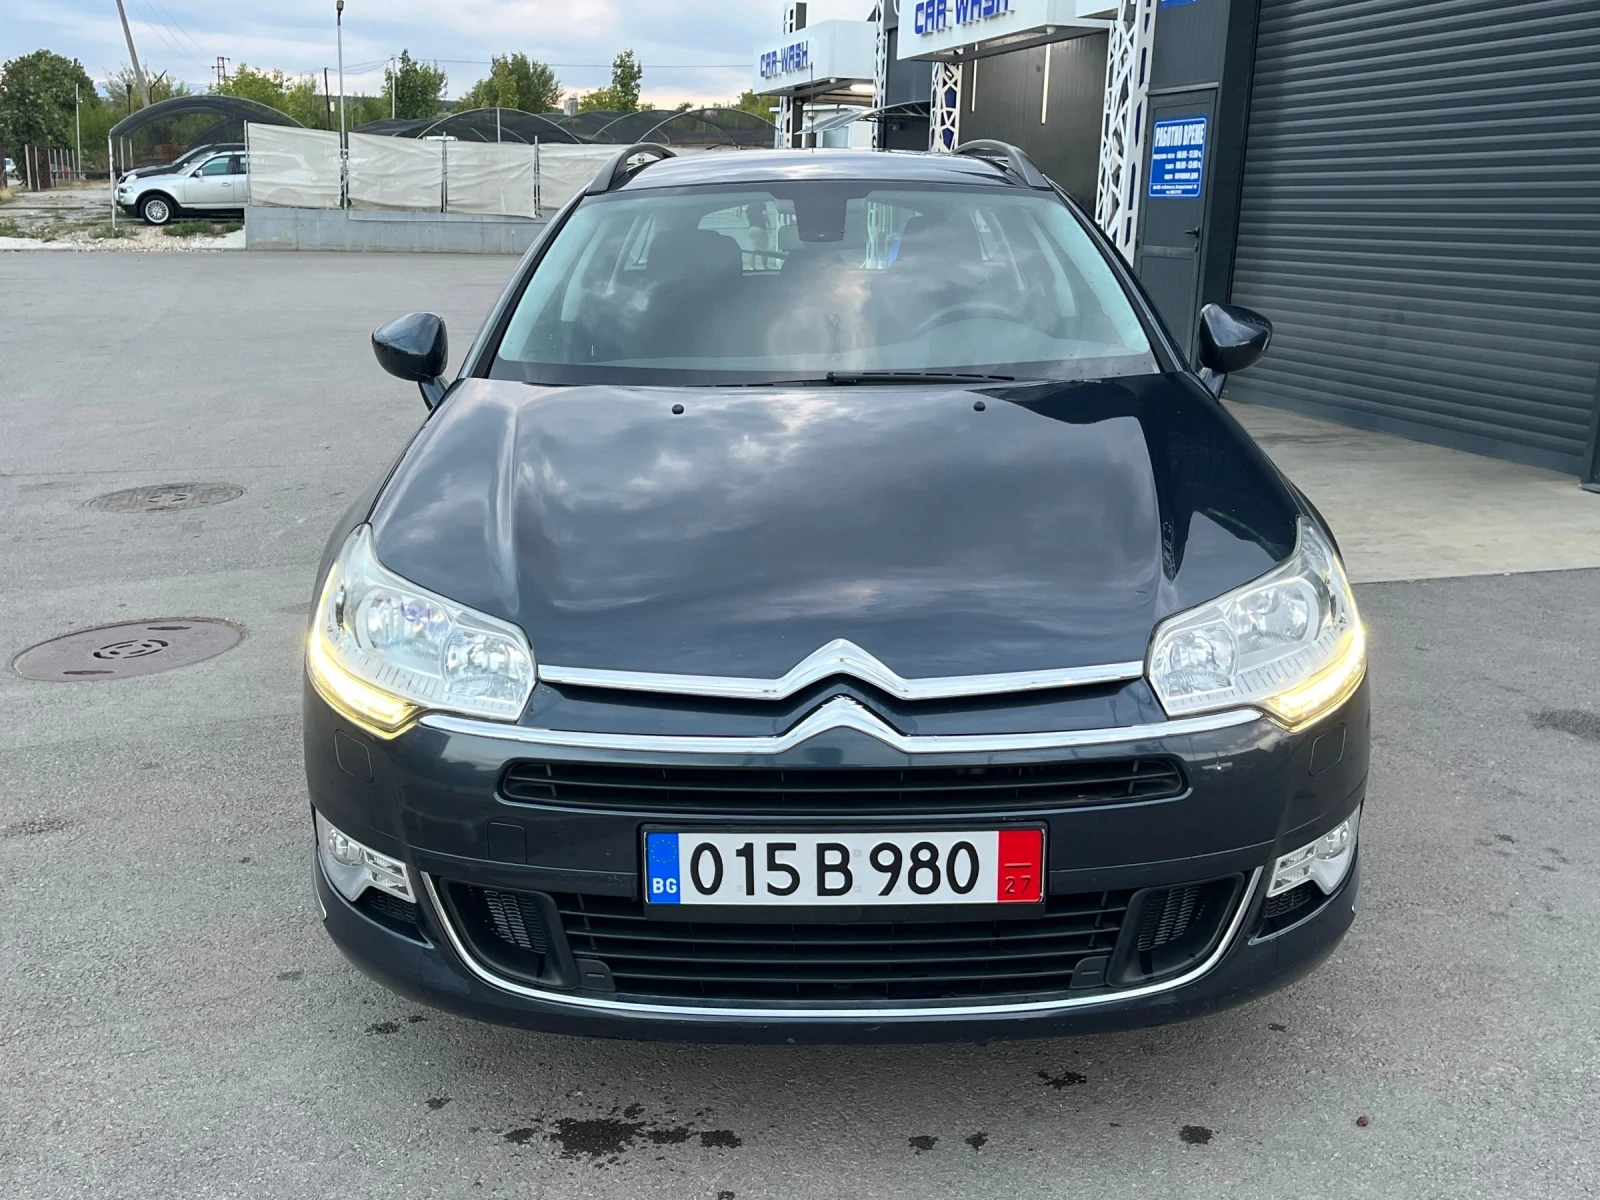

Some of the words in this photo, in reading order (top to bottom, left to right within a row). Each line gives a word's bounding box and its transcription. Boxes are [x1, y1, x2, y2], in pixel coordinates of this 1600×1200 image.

[915, 0, 947, 34] CAR
[761, 50, 777, 77] CAR
[781, 40, 808, 72] WASH
[652, 878, 677, 894] BG
[1005, 875, 1031, 894] 27
